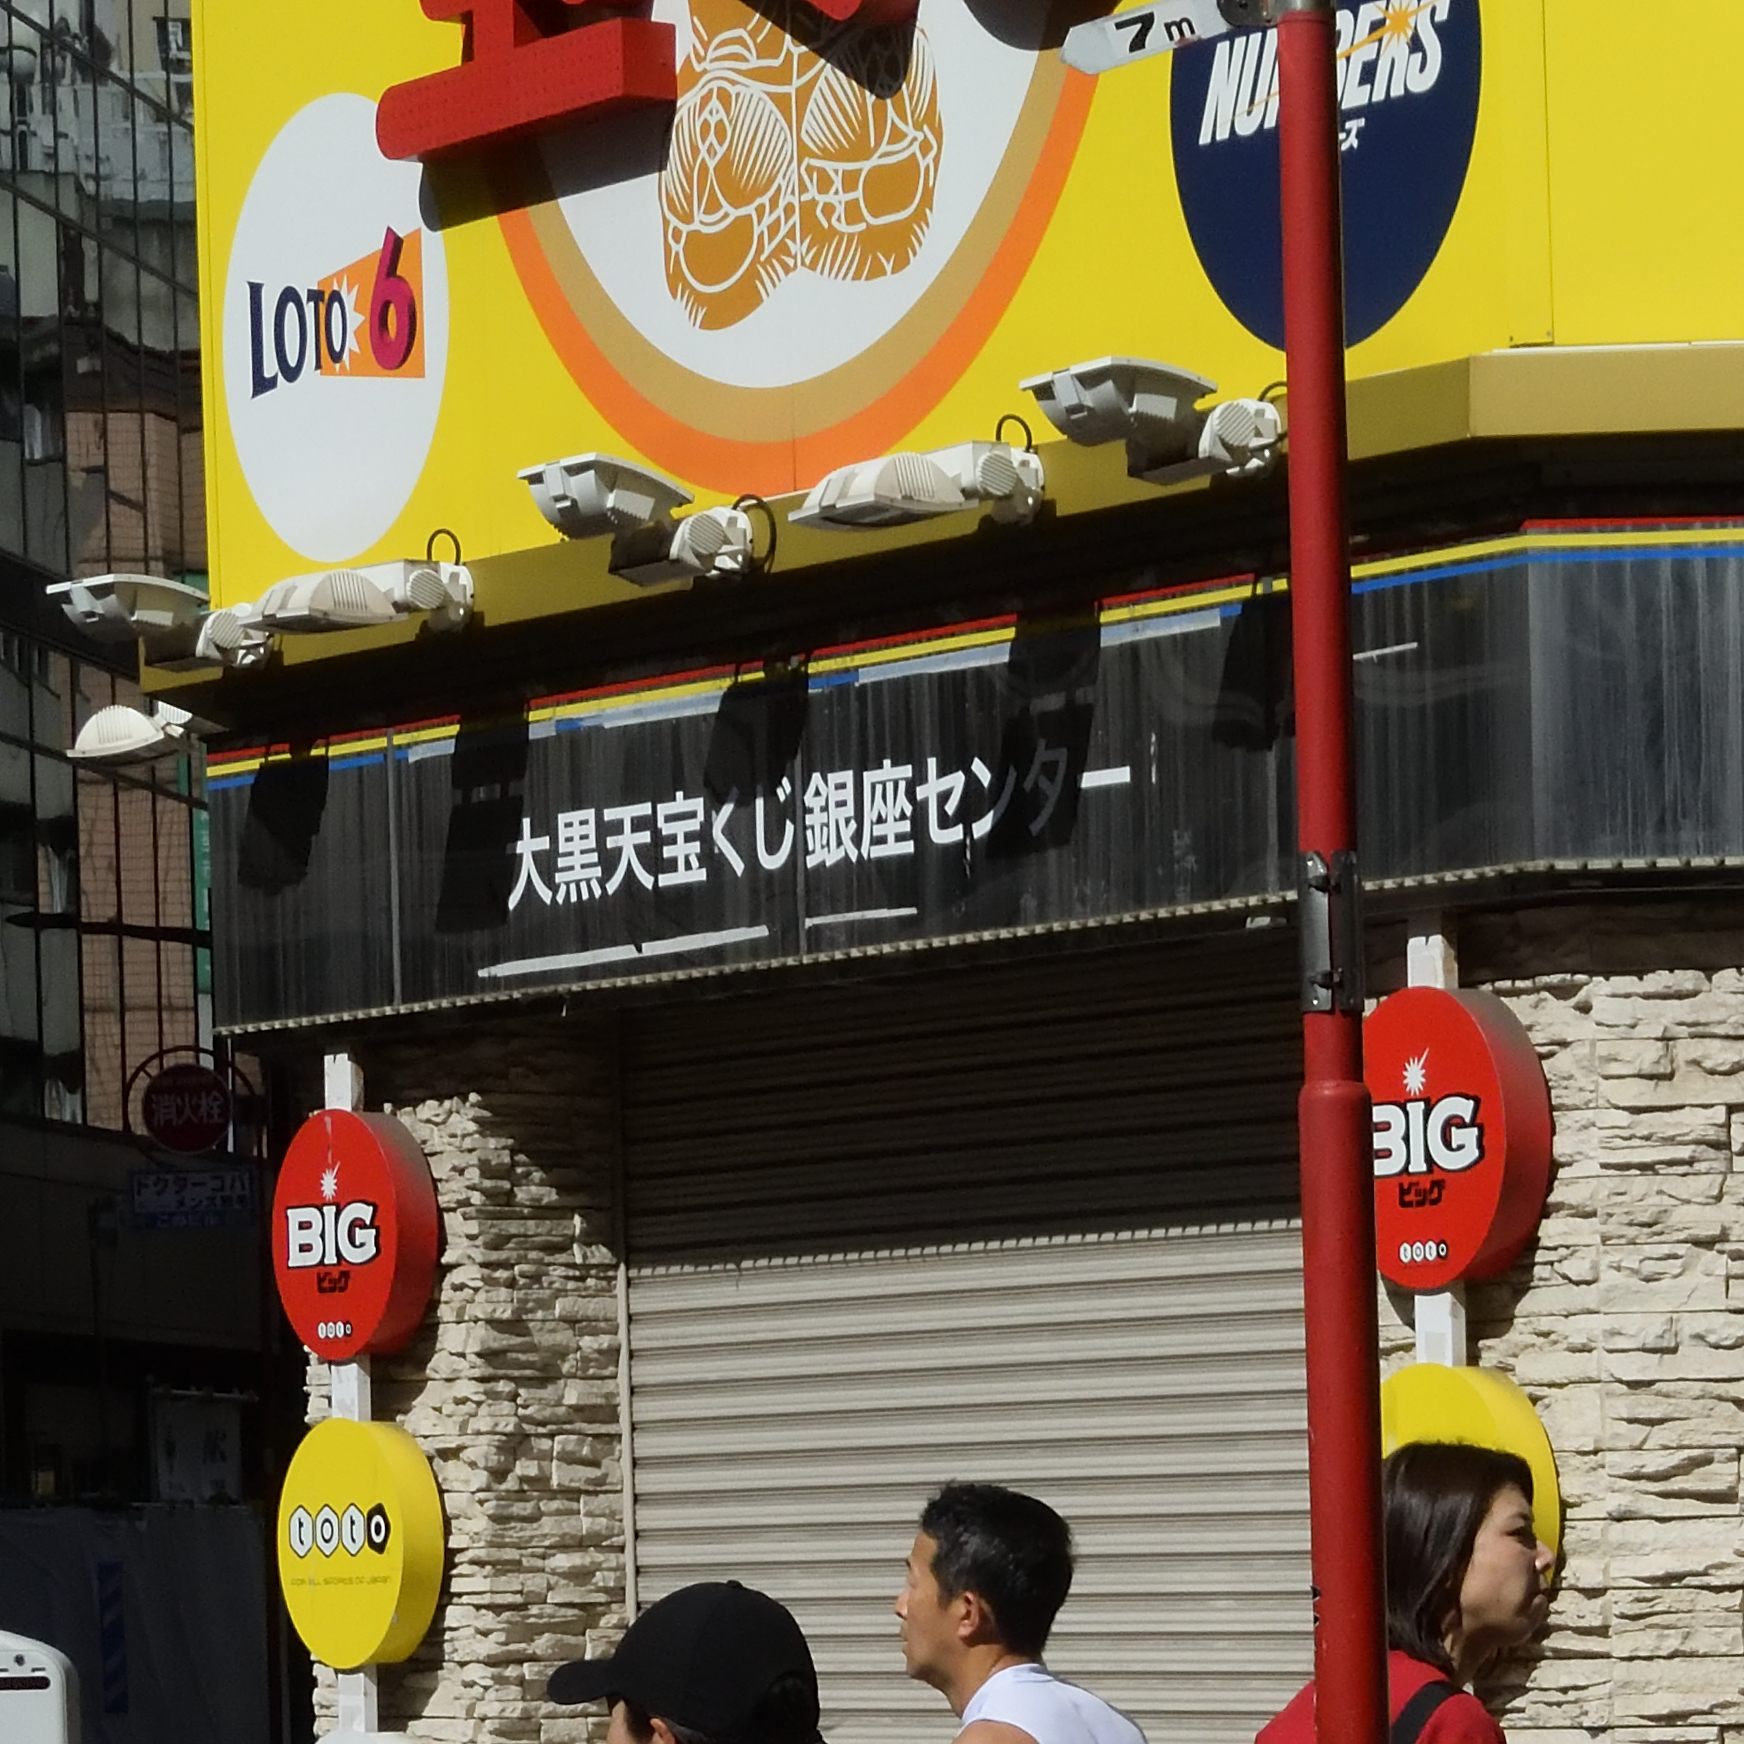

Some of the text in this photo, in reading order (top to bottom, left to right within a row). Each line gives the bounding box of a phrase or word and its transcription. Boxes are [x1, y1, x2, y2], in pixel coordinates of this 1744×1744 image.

[246, 226, 417, 400] LOTO 6
[507, 737, 1131, 911] 大黒天宝くじ銀座センター
[151, 1090, 225, 1128] 消火栓
[1372, 1096, 1481, 1176] BIG
[1398, 1179, 1446, 1208] ビッグ
[286, 1202, 379, 1268] BIG
[1400, 1241, 1447, 1262] toto
[292, 1507, 388, 1553] toto
